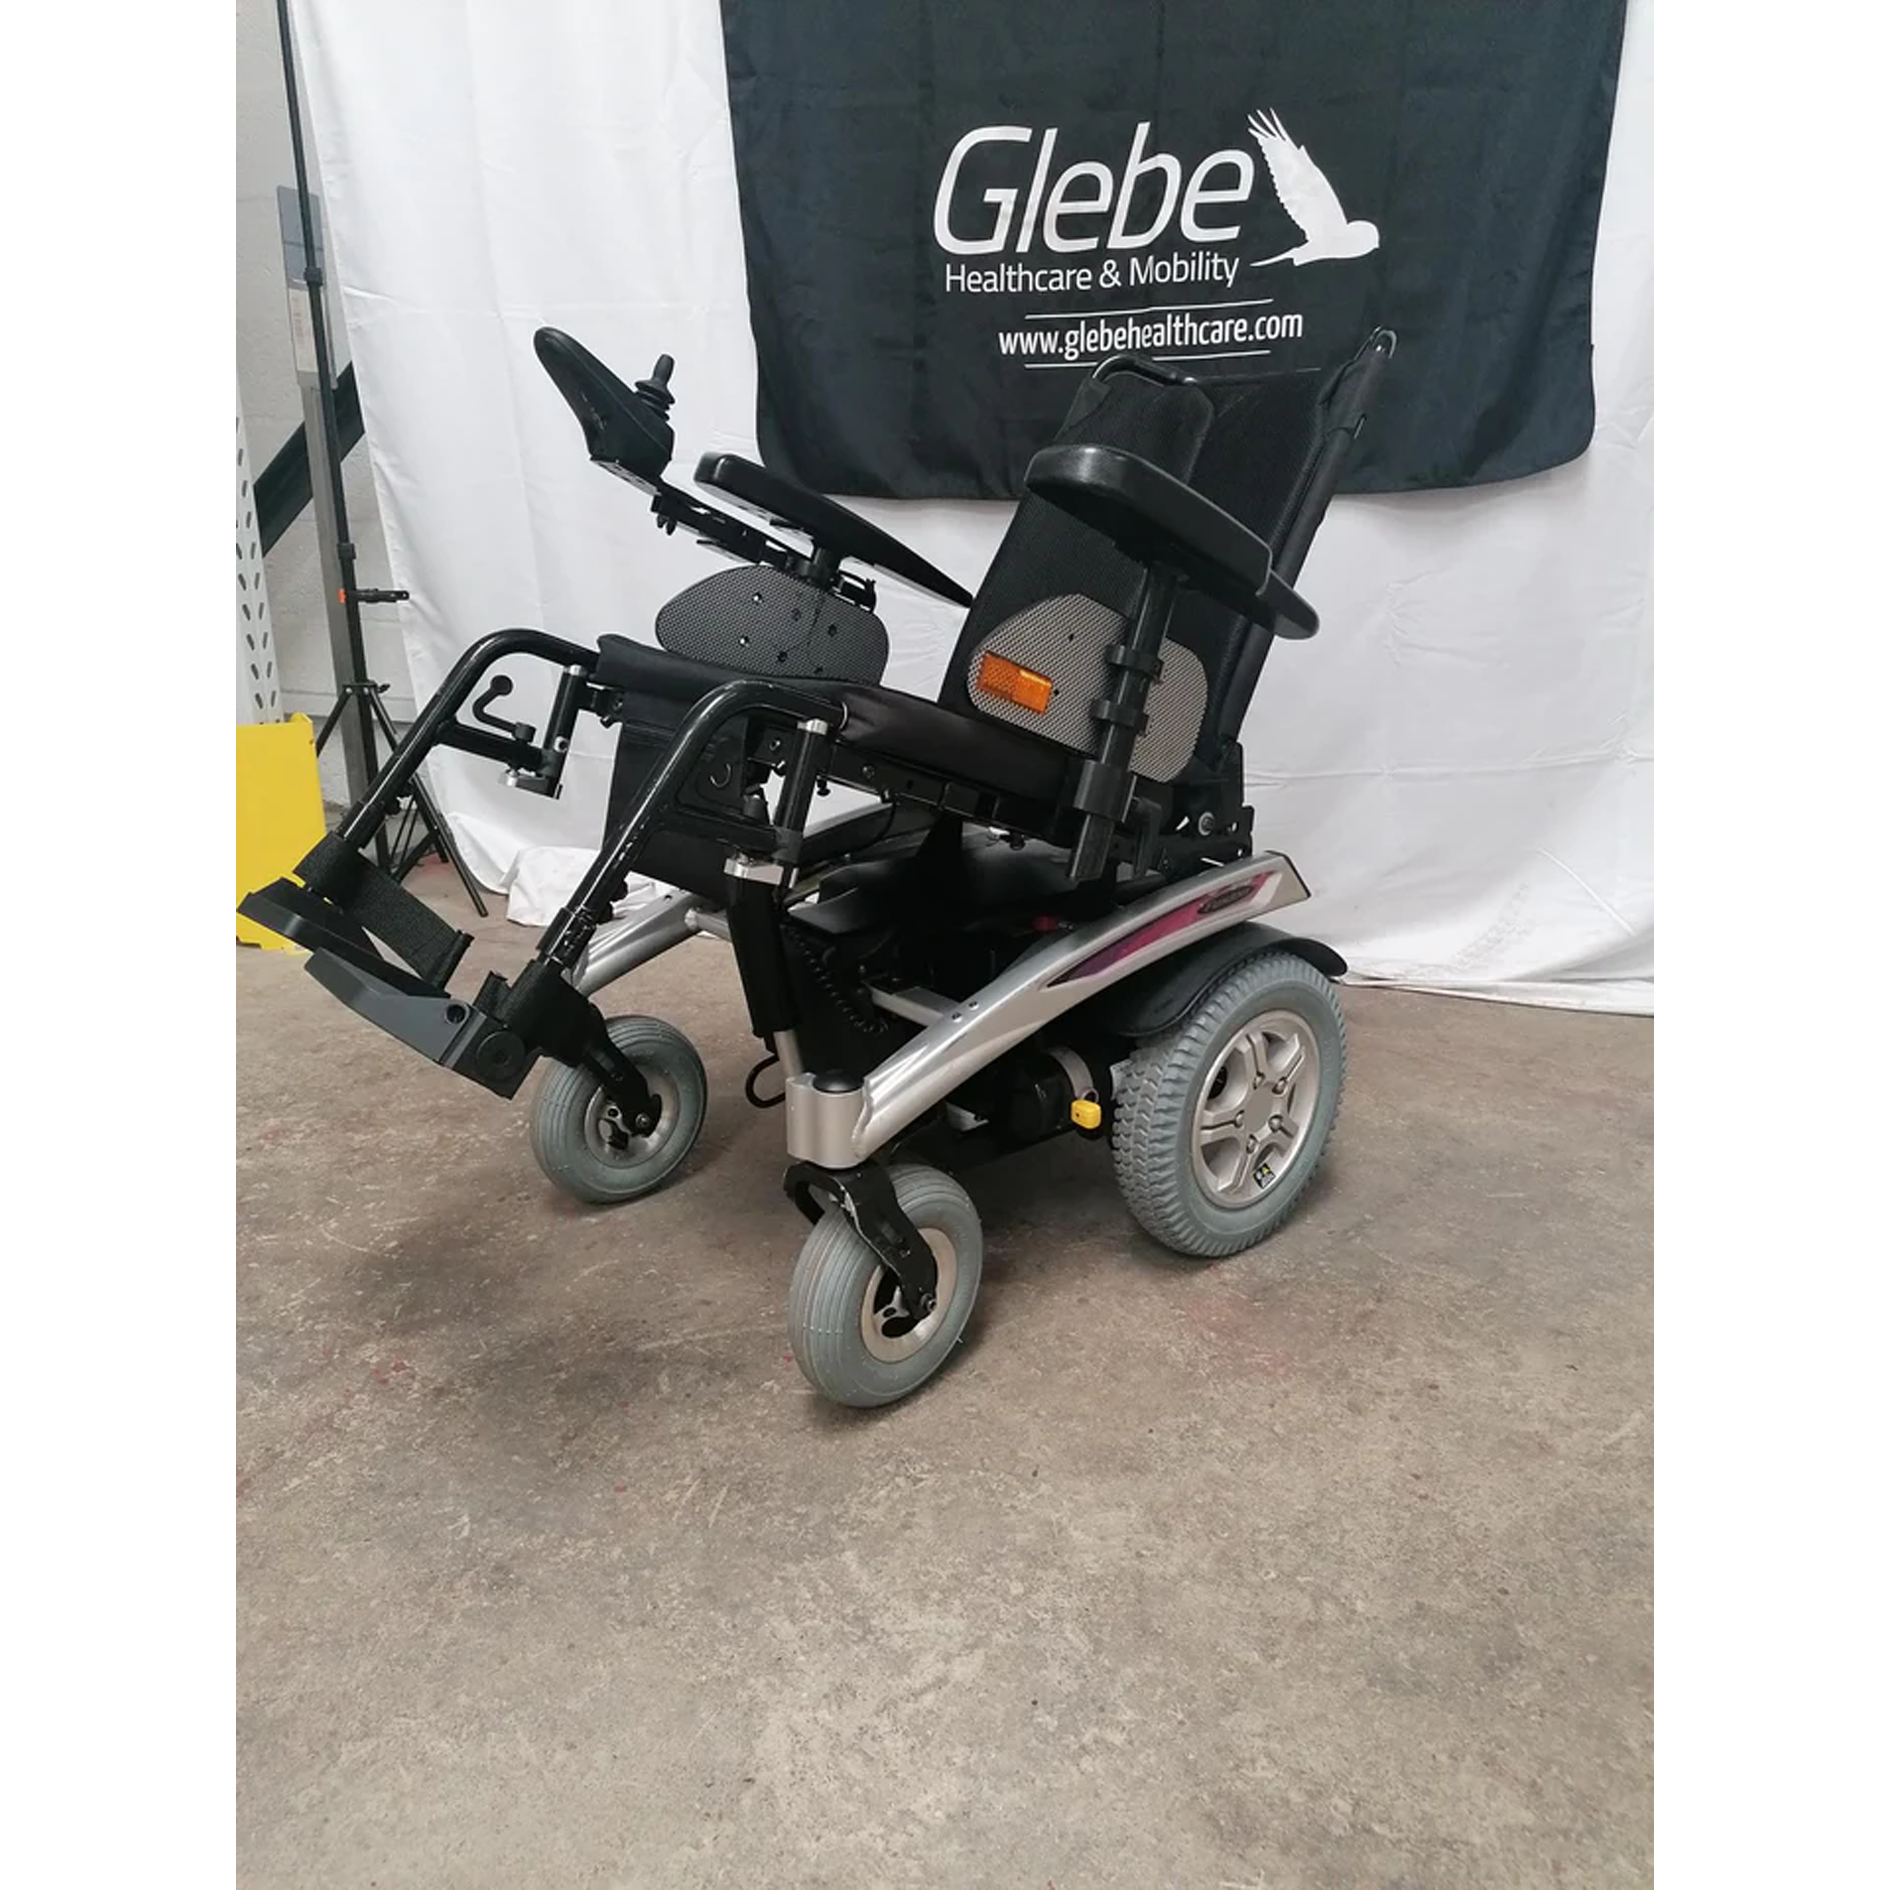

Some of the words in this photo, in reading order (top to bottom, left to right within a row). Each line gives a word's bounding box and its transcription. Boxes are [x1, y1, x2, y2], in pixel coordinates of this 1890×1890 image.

[933, 121, 1255, 255] Glebe
[945, 258, 1092, 292] Healthcare
[1098, 259, 1122, 289] &
[1129, 250, 1240, 288] Mobility
[998, 312, 1303, 361] www.glebehealthcare.com
